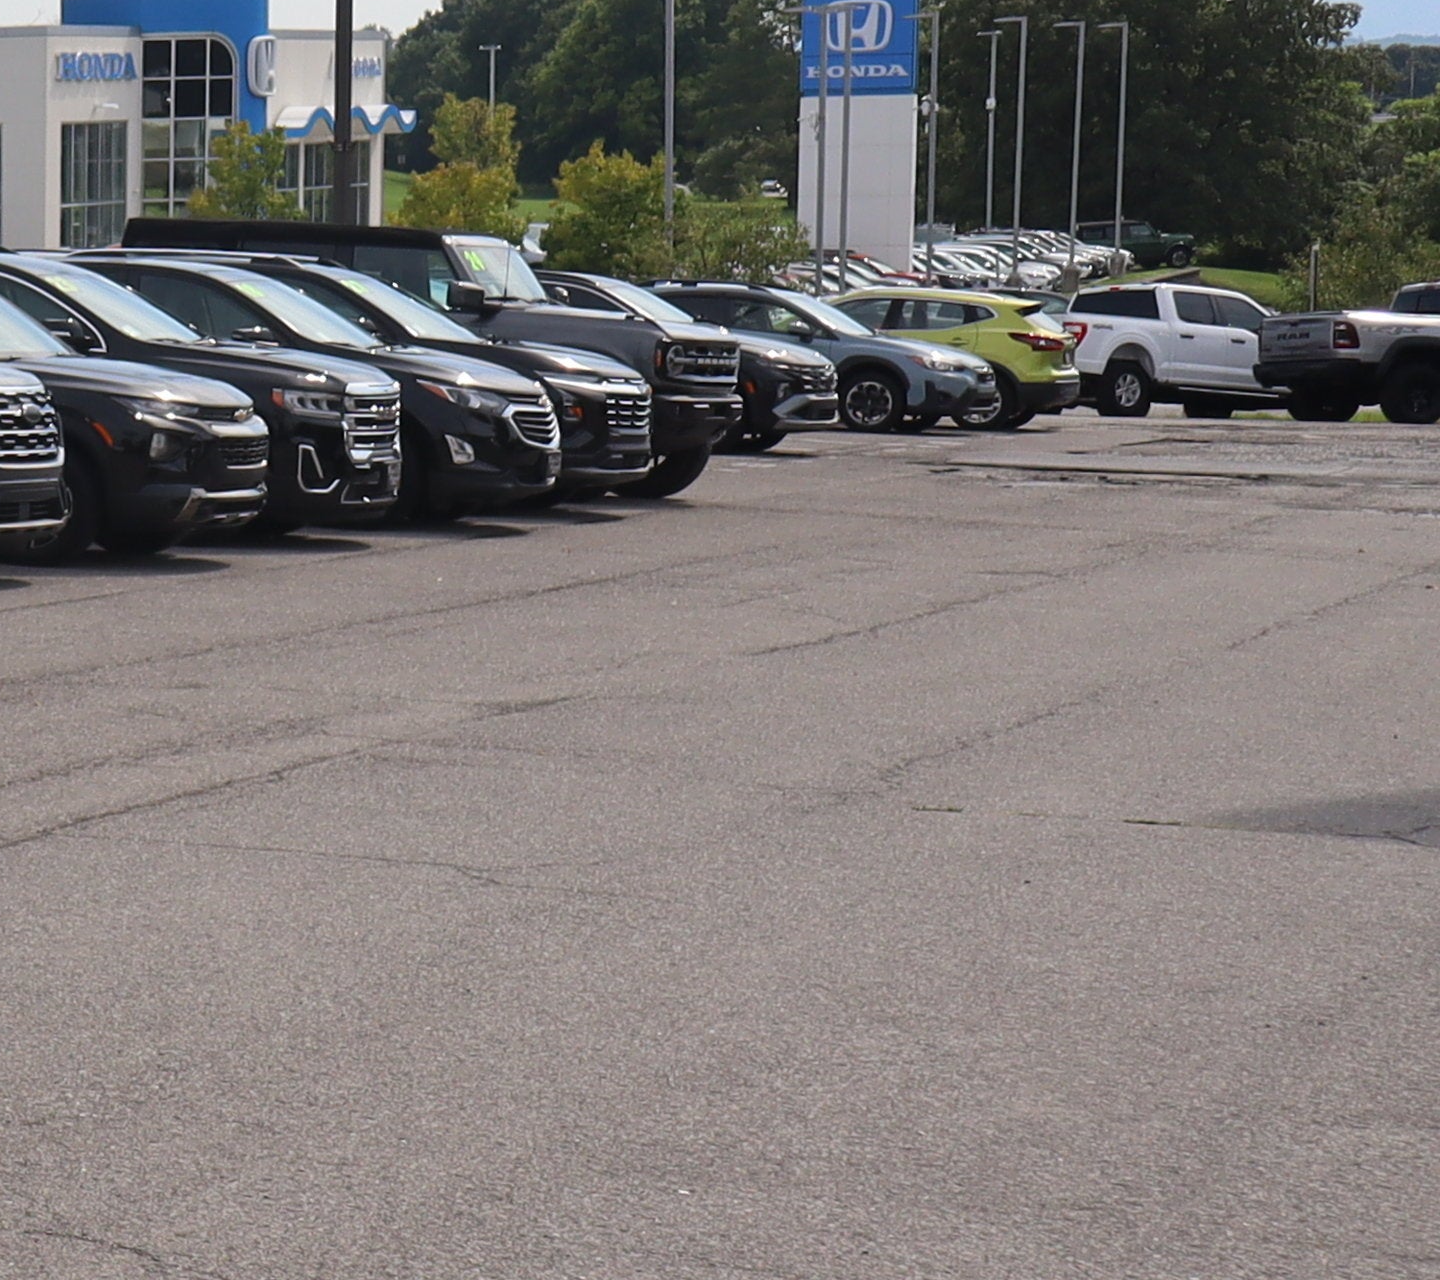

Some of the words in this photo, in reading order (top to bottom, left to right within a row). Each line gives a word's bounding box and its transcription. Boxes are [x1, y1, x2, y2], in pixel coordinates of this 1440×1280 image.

[55, 52, 138, 82] HONDA
[806, 63, 909, 79] HONDA
[1276, 332, 1310, 341] RAM
